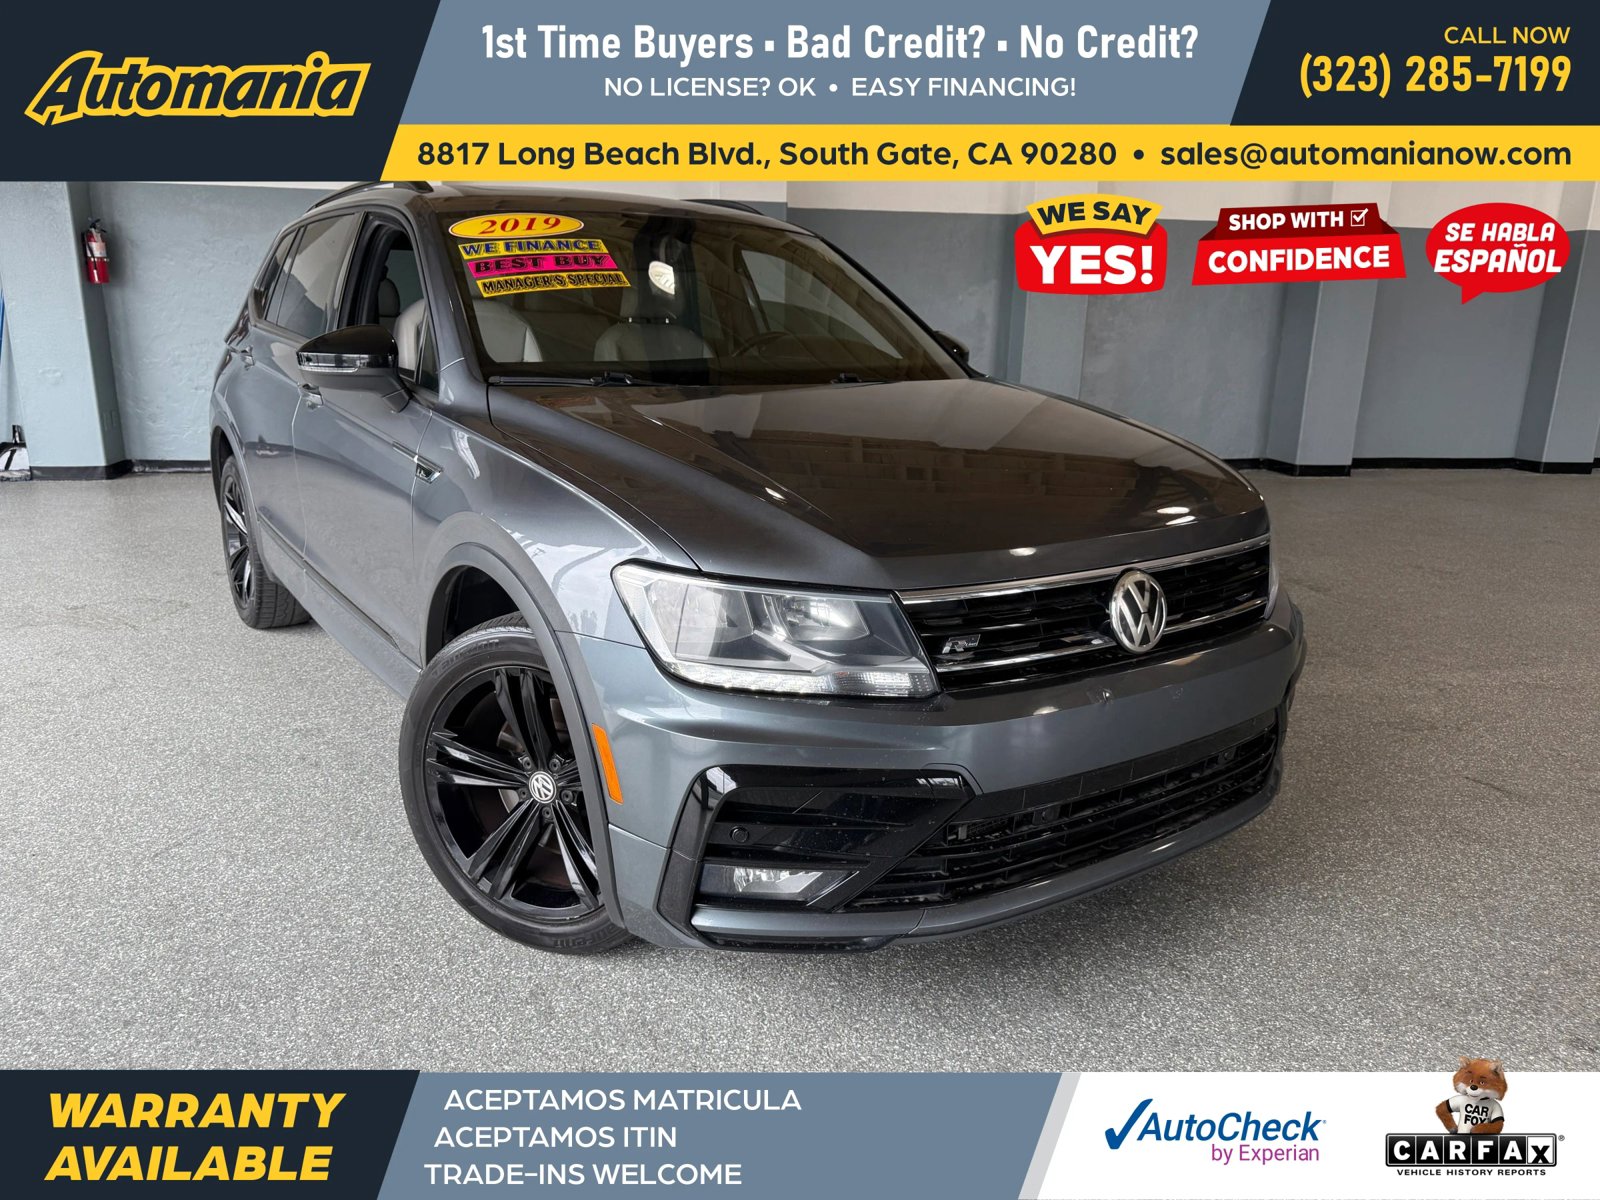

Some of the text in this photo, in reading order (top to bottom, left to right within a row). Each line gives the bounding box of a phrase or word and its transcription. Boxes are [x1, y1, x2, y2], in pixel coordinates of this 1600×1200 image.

[479, 217, 561, 235] 2019
[463, 240, 600, 256] WE FINANCE
[475, 255, 608, 273] BEST BUY
[482, 272, 625, 294] MANAGER'S SPECIAL
